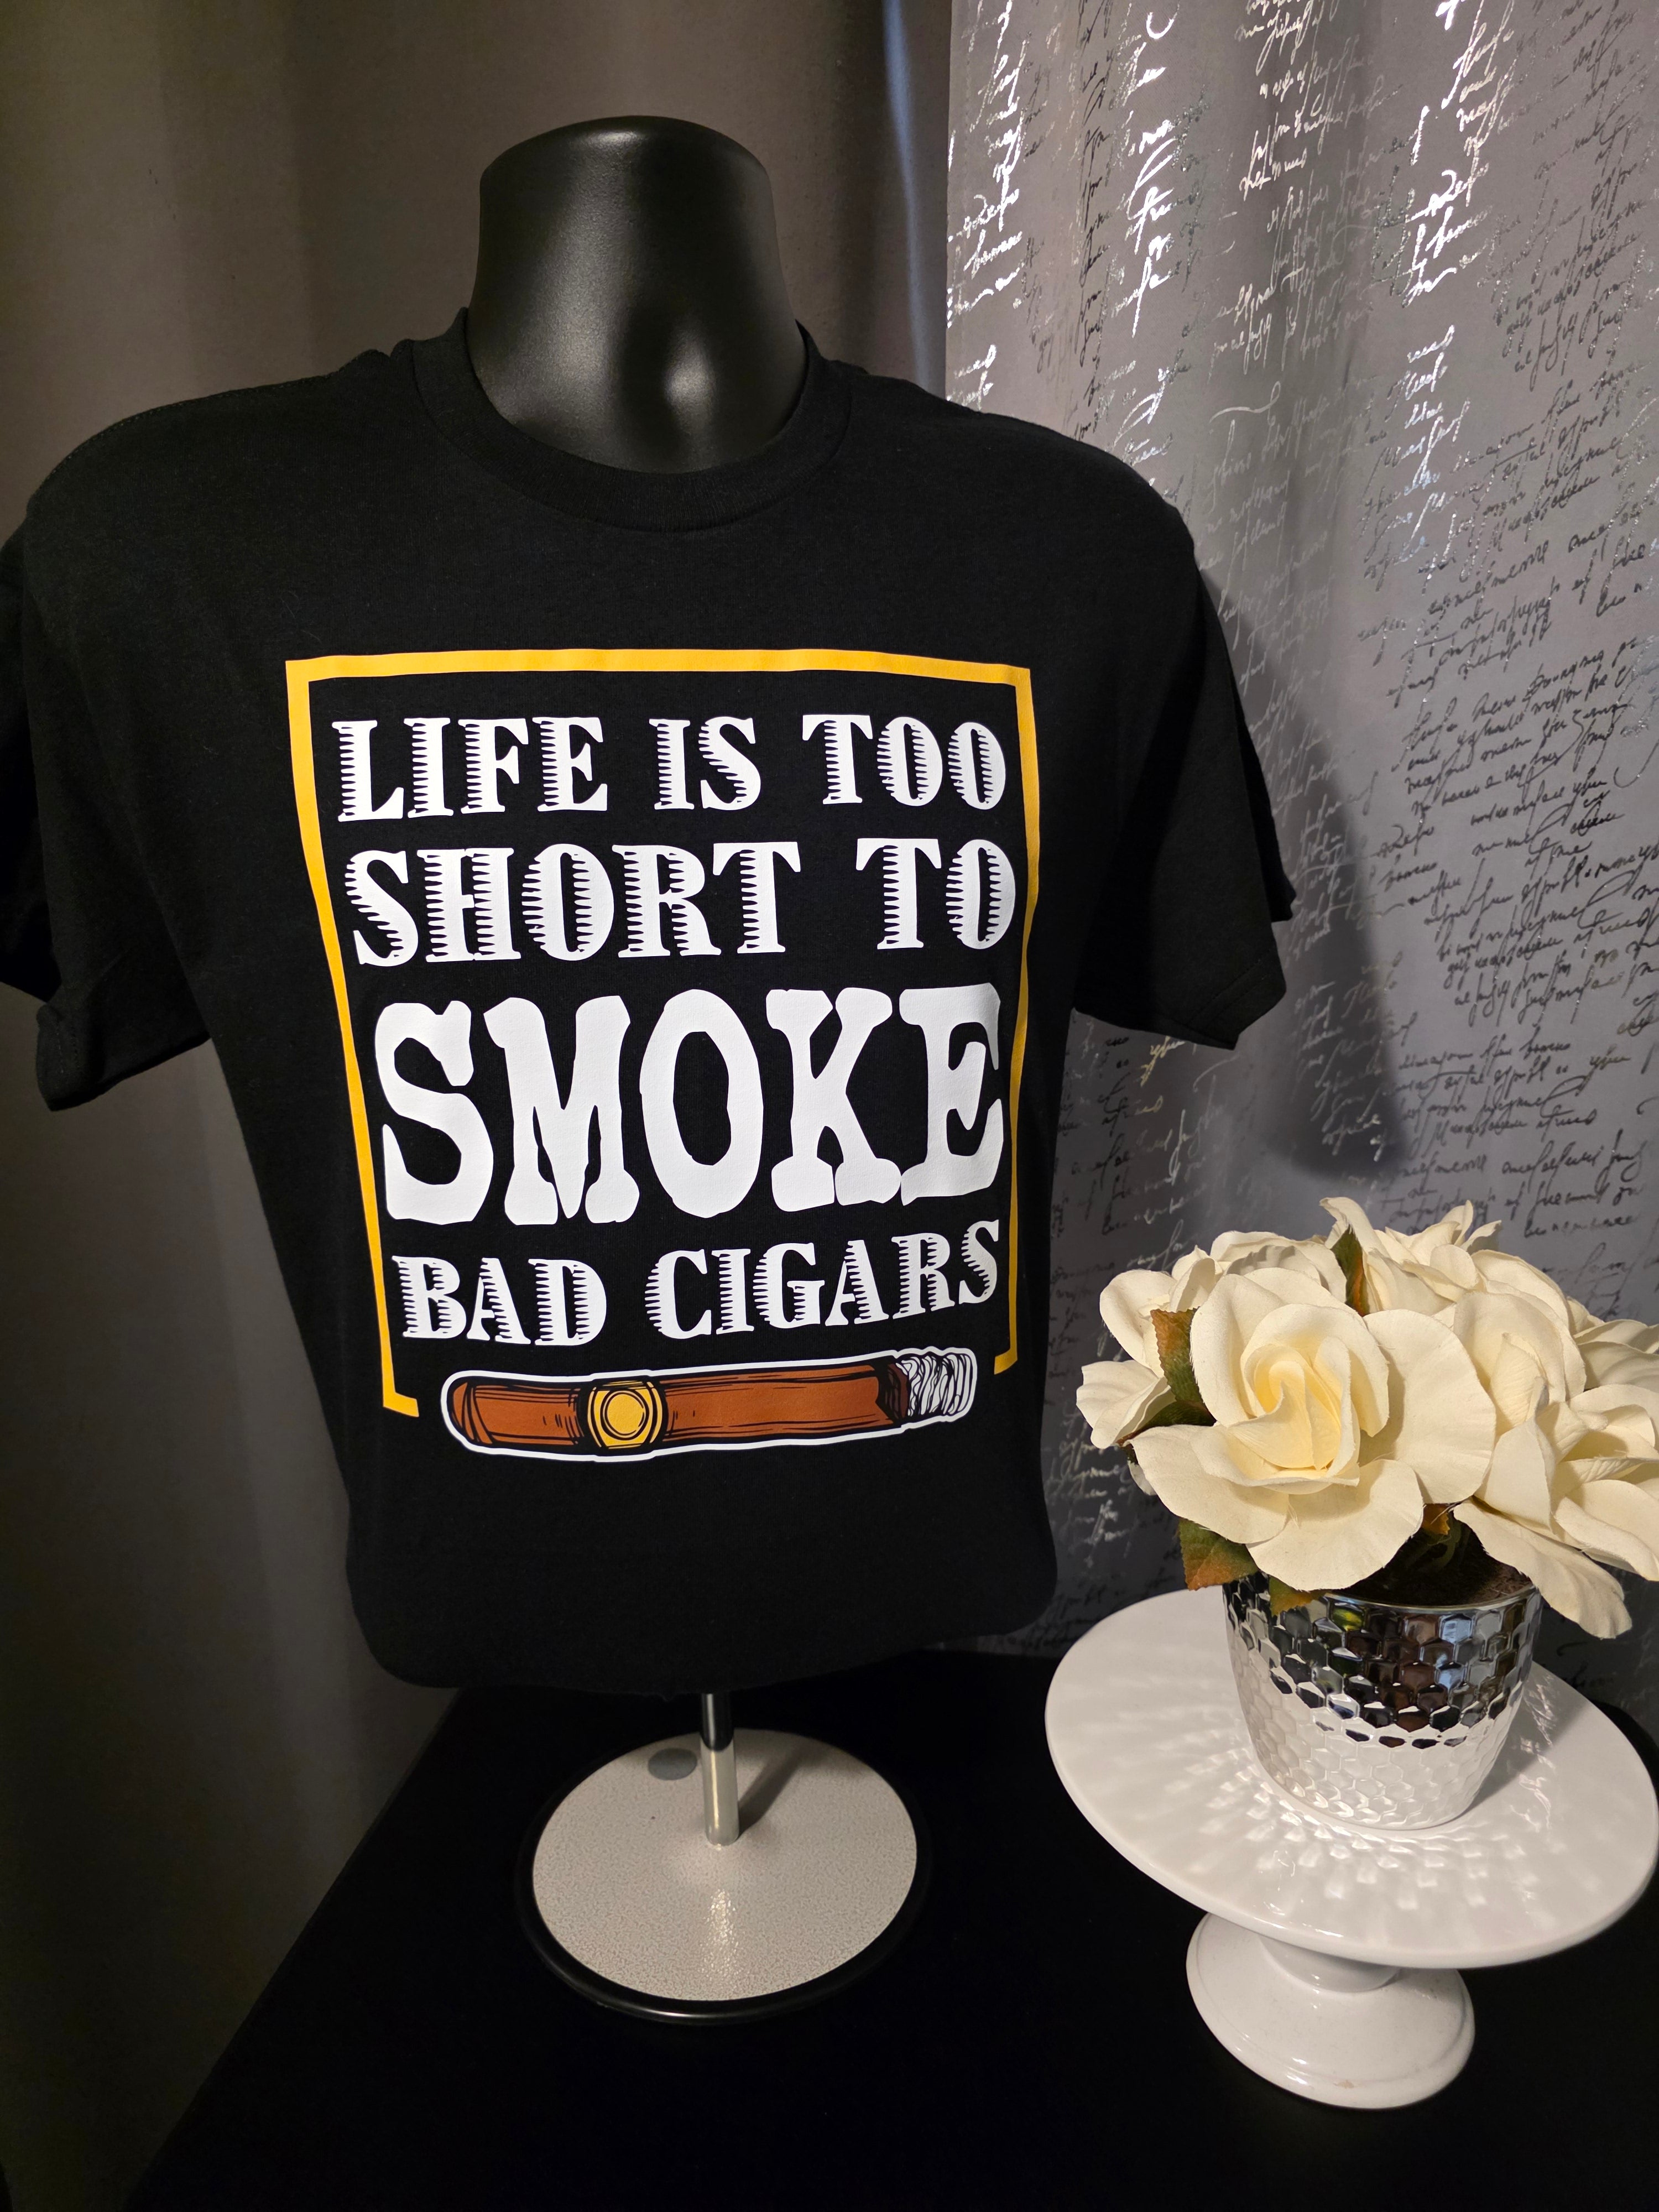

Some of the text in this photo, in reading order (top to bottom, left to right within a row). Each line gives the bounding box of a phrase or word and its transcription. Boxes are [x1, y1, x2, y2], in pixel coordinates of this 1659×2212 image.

[331, 714, 1006, 822] LIFE IS TOO
[345, 838, 1016, 967] SHORT TO
[374, 982, 1004, 1226] SMOKE
[391, 1219, 999, 1346] BAD CIGARS
